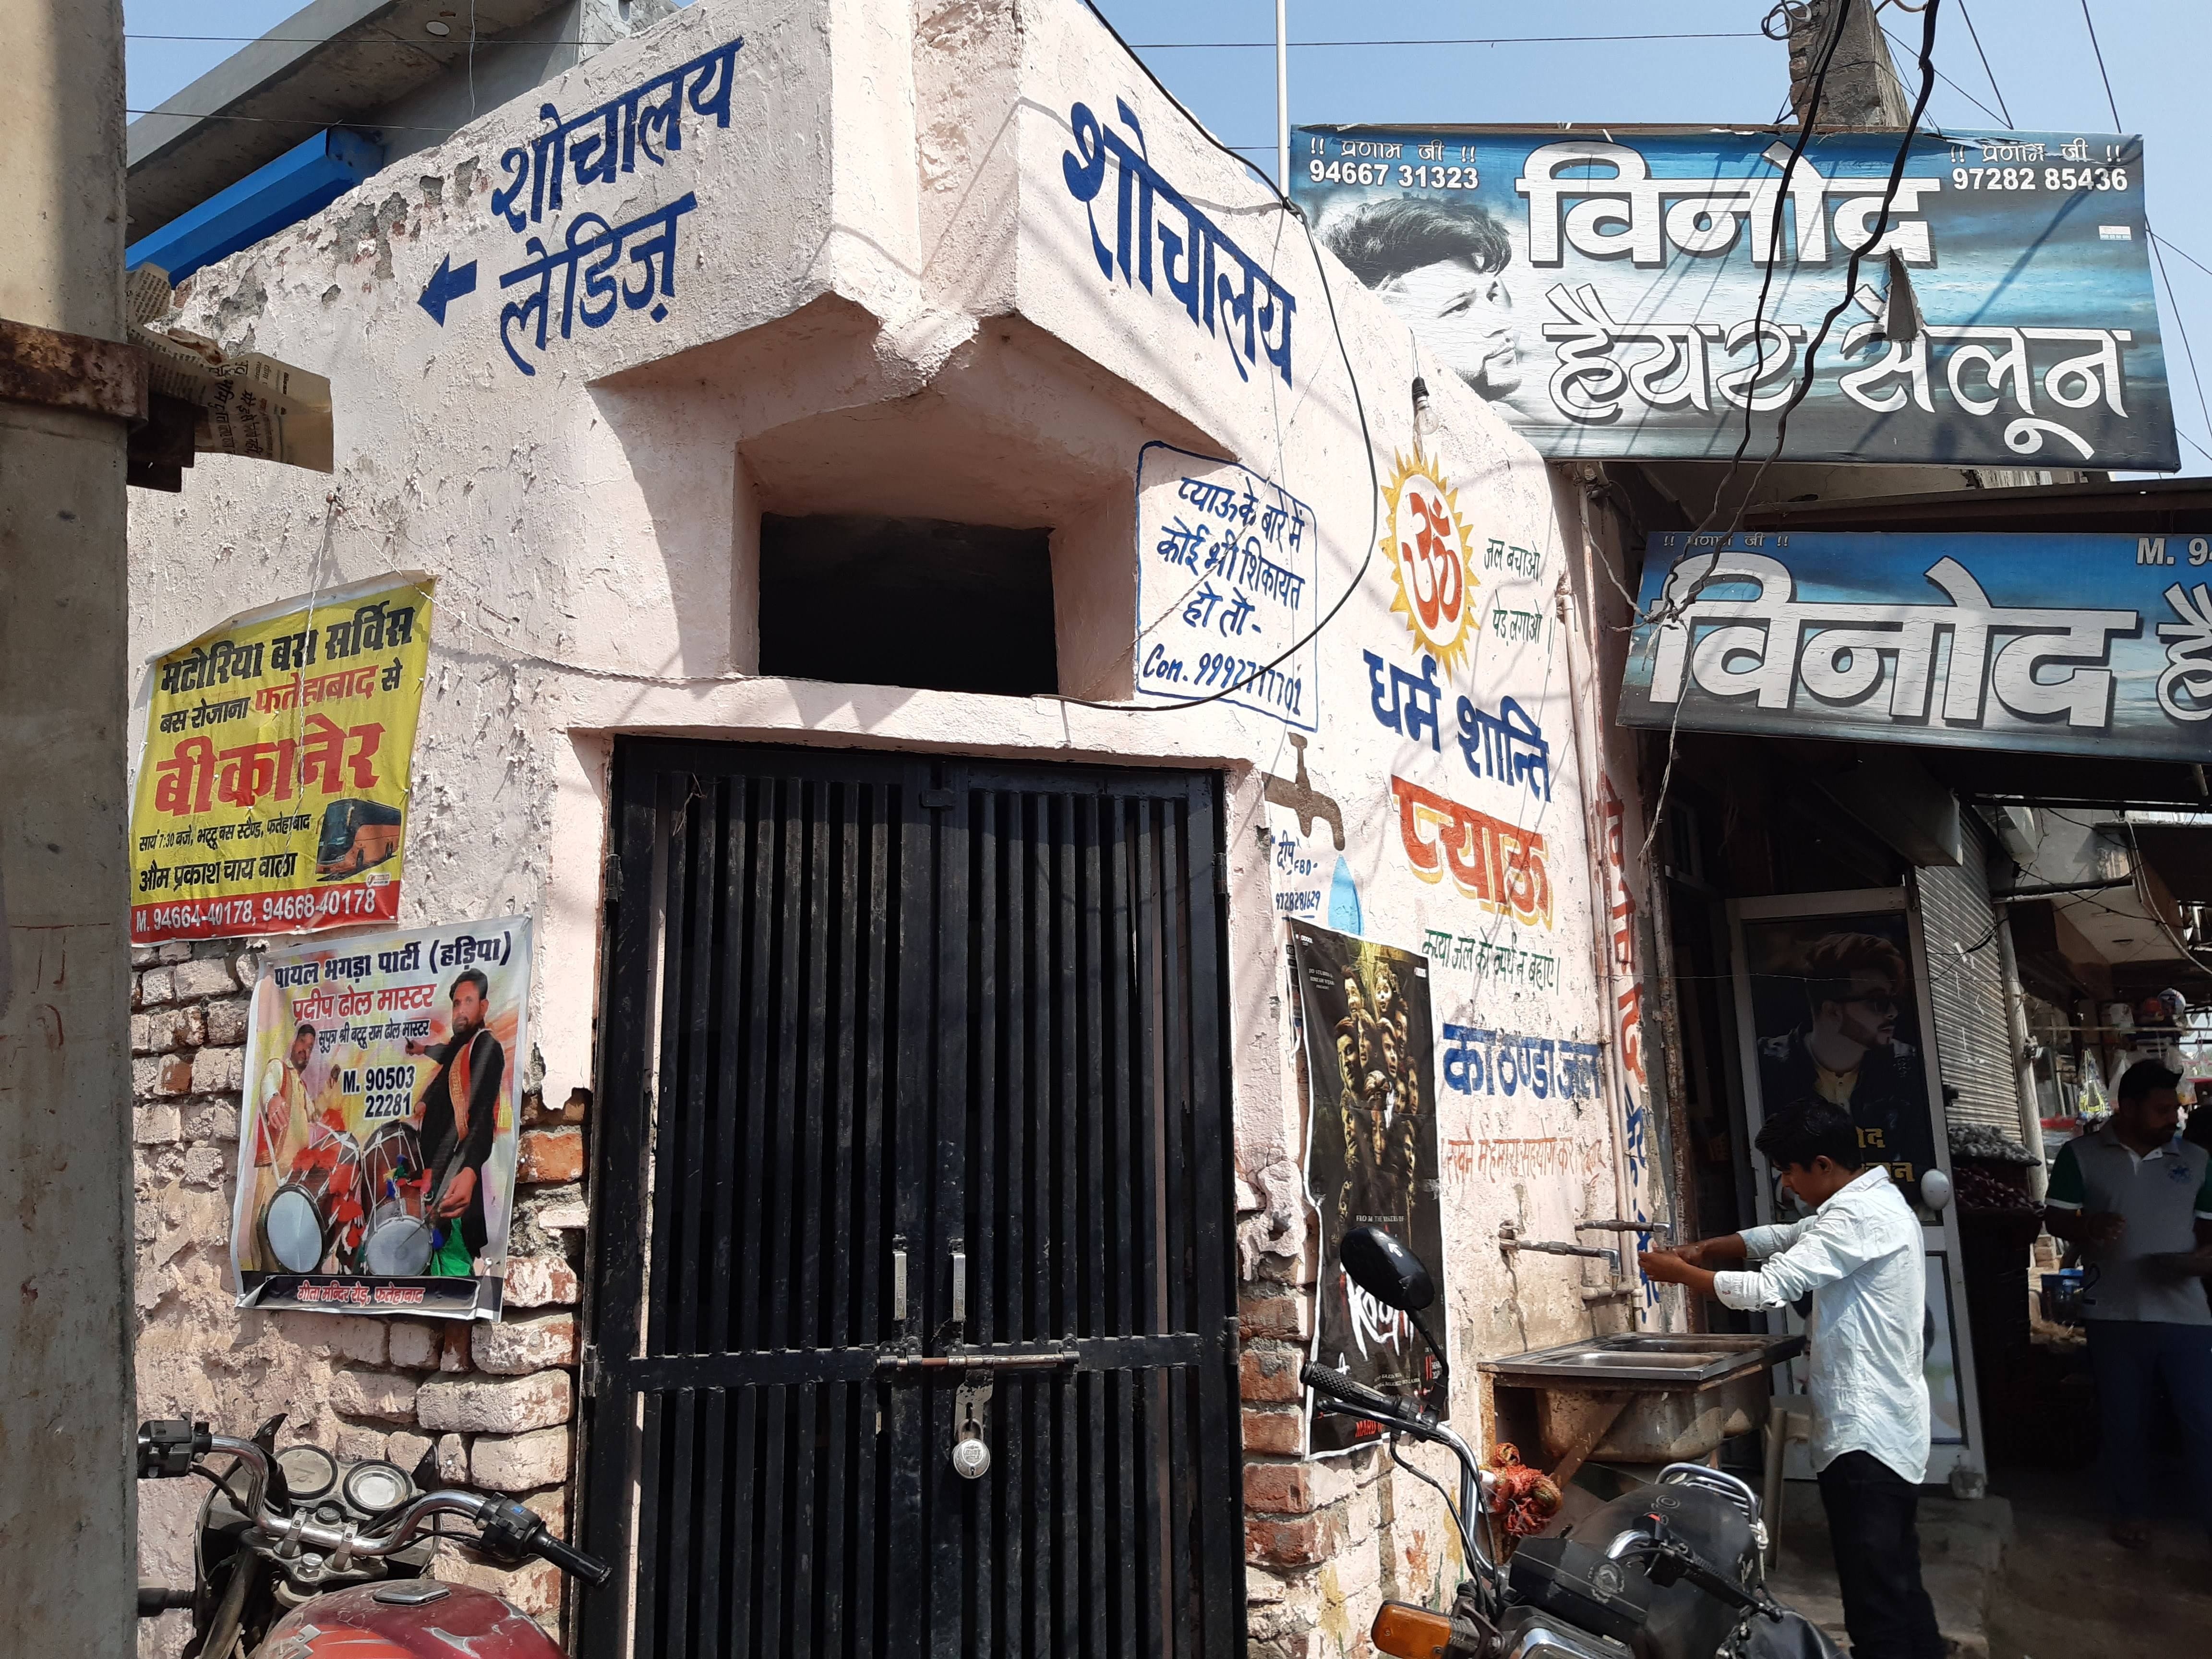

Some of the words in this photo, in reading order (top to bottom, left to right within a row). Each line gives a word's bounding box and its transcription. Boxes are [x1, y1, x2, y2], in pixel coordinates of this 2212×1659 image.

[491, 36, 745, 233] शोचालय
[1341, 140, 1403, 159] प्रणाम
[1418, 139, 1445, 161] जी
[1982, 143, 2045, 162] प्रणाम
[2060, 137, 2088, 162] जी
[1310, 159, 1389, 186] 94667
[1398, 165, 1479, 189] 31323
[1952, 168, 2036, 190] 97282
[2045, 168, 2128, 191] 85436
[1515, 140, 1941, 266] विनोद
[1178, 477, 1238, 522] प्याऊ
[1239, 476, 1259, 526] के
[1262, 489, 1288, 553] बारे
[1484, 538, 1504, 571] जल
[1744, 532, 1765, 546] जी
[1157, 516, 1211, 576] कोई
[1204, 529, 1239, 581] भी
[1239, 536, 1306, 610] शिकायत
[1183, 581, 1223, 627] हो
[271, 629, 319, 672] बस
[325, 601, 416, 660] सर्विस
[1650, 552, 2139, 728] विनोद
[160, 709, 188, 734] बस
[192, 697, 251, 729] रोजाना
[255, 664, 380, 714] फतेहाबाद
[381, 657, 403, 691] से
[155, 713, 386, 817] बीकानेर
[159, 833, 175, 849] 7:30
[219, 824, 235, 841] बस
[267, 811, 312, 835] फतेहाबाद
[173, 861, 220, 892] प्रकाश
[224, 857, 257, 882] चाय
[259, 852, 299, 879] वाला
[262, 888, 376, 923] 94668-40178
[275, 961, 319, 989] पायल
[378, 941, 422, 973] पार्टी
[292, 986, 334, 1027] प्रदीप
[338, 984, 374, 1017] ढोल
[376, 983, 437, 1011] मास्टर
[339, 1025, 350, 1044] श्री
[368, 1024, 384, 1042] राम
[385, 1017, 401, 1040] ढोल
[402, 1020, 431, 1039] मास्टर
[343, 1070, 361, 1094] M.
[365, 1065, 416, 1092] 90503
[364, 1092, 411, 1118] 22281
[297, 1279, 322, 1302] गीता
[374, 1280, 426, 1305] फतेहाबाद
